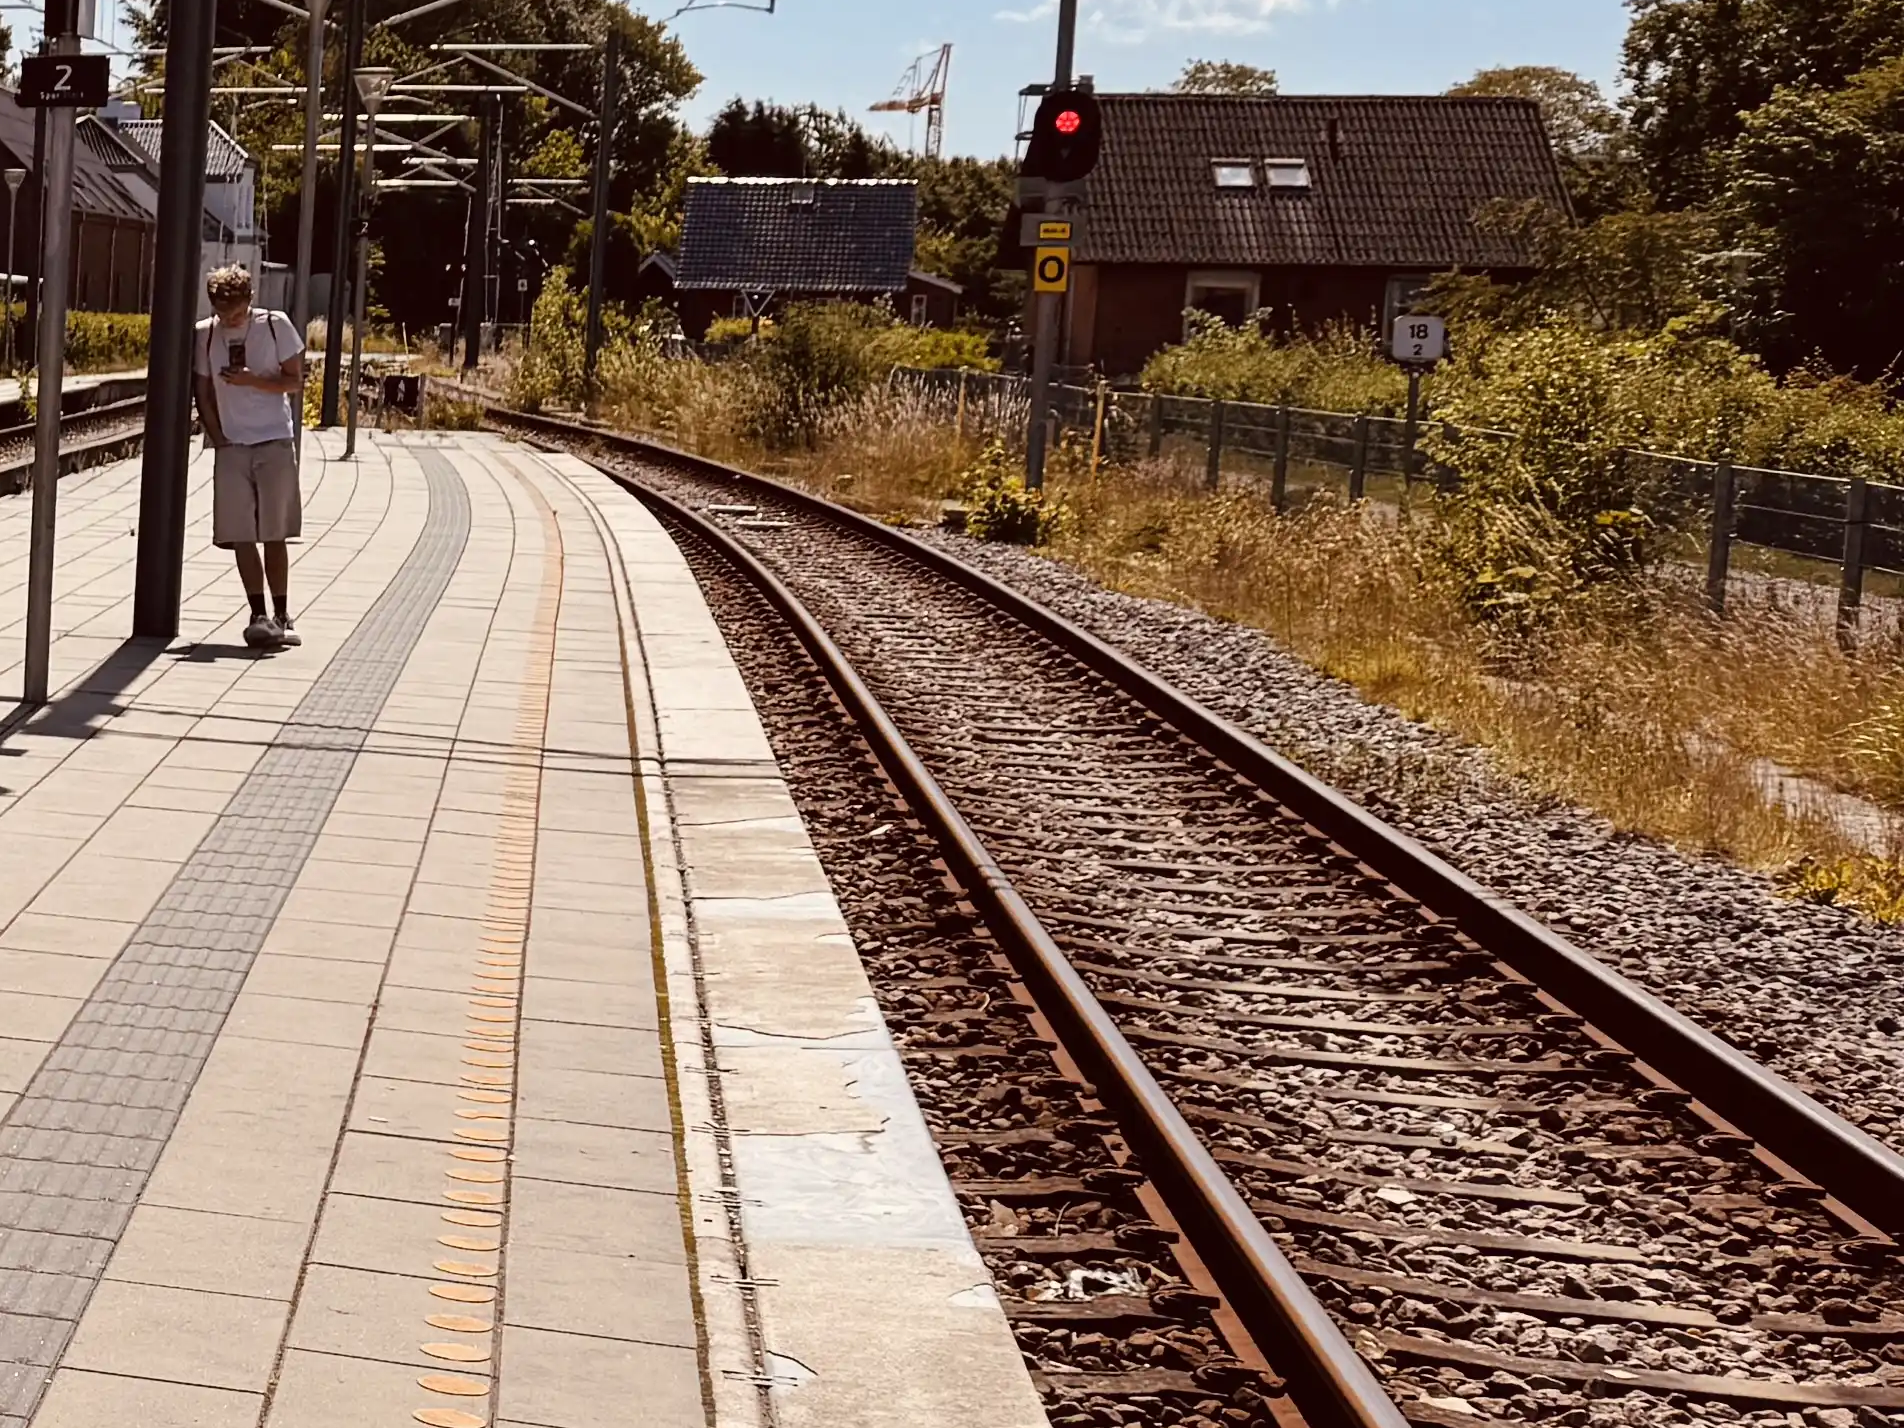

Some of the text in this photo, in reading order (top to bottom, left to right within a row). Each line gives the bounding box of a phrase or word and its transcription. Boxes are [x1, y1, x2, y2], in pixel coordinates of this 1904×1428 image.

[53, 64, 72, 91] 2
[1408, 323, 1428, 339] 18
[1412, 343, 1423, 356] 2
